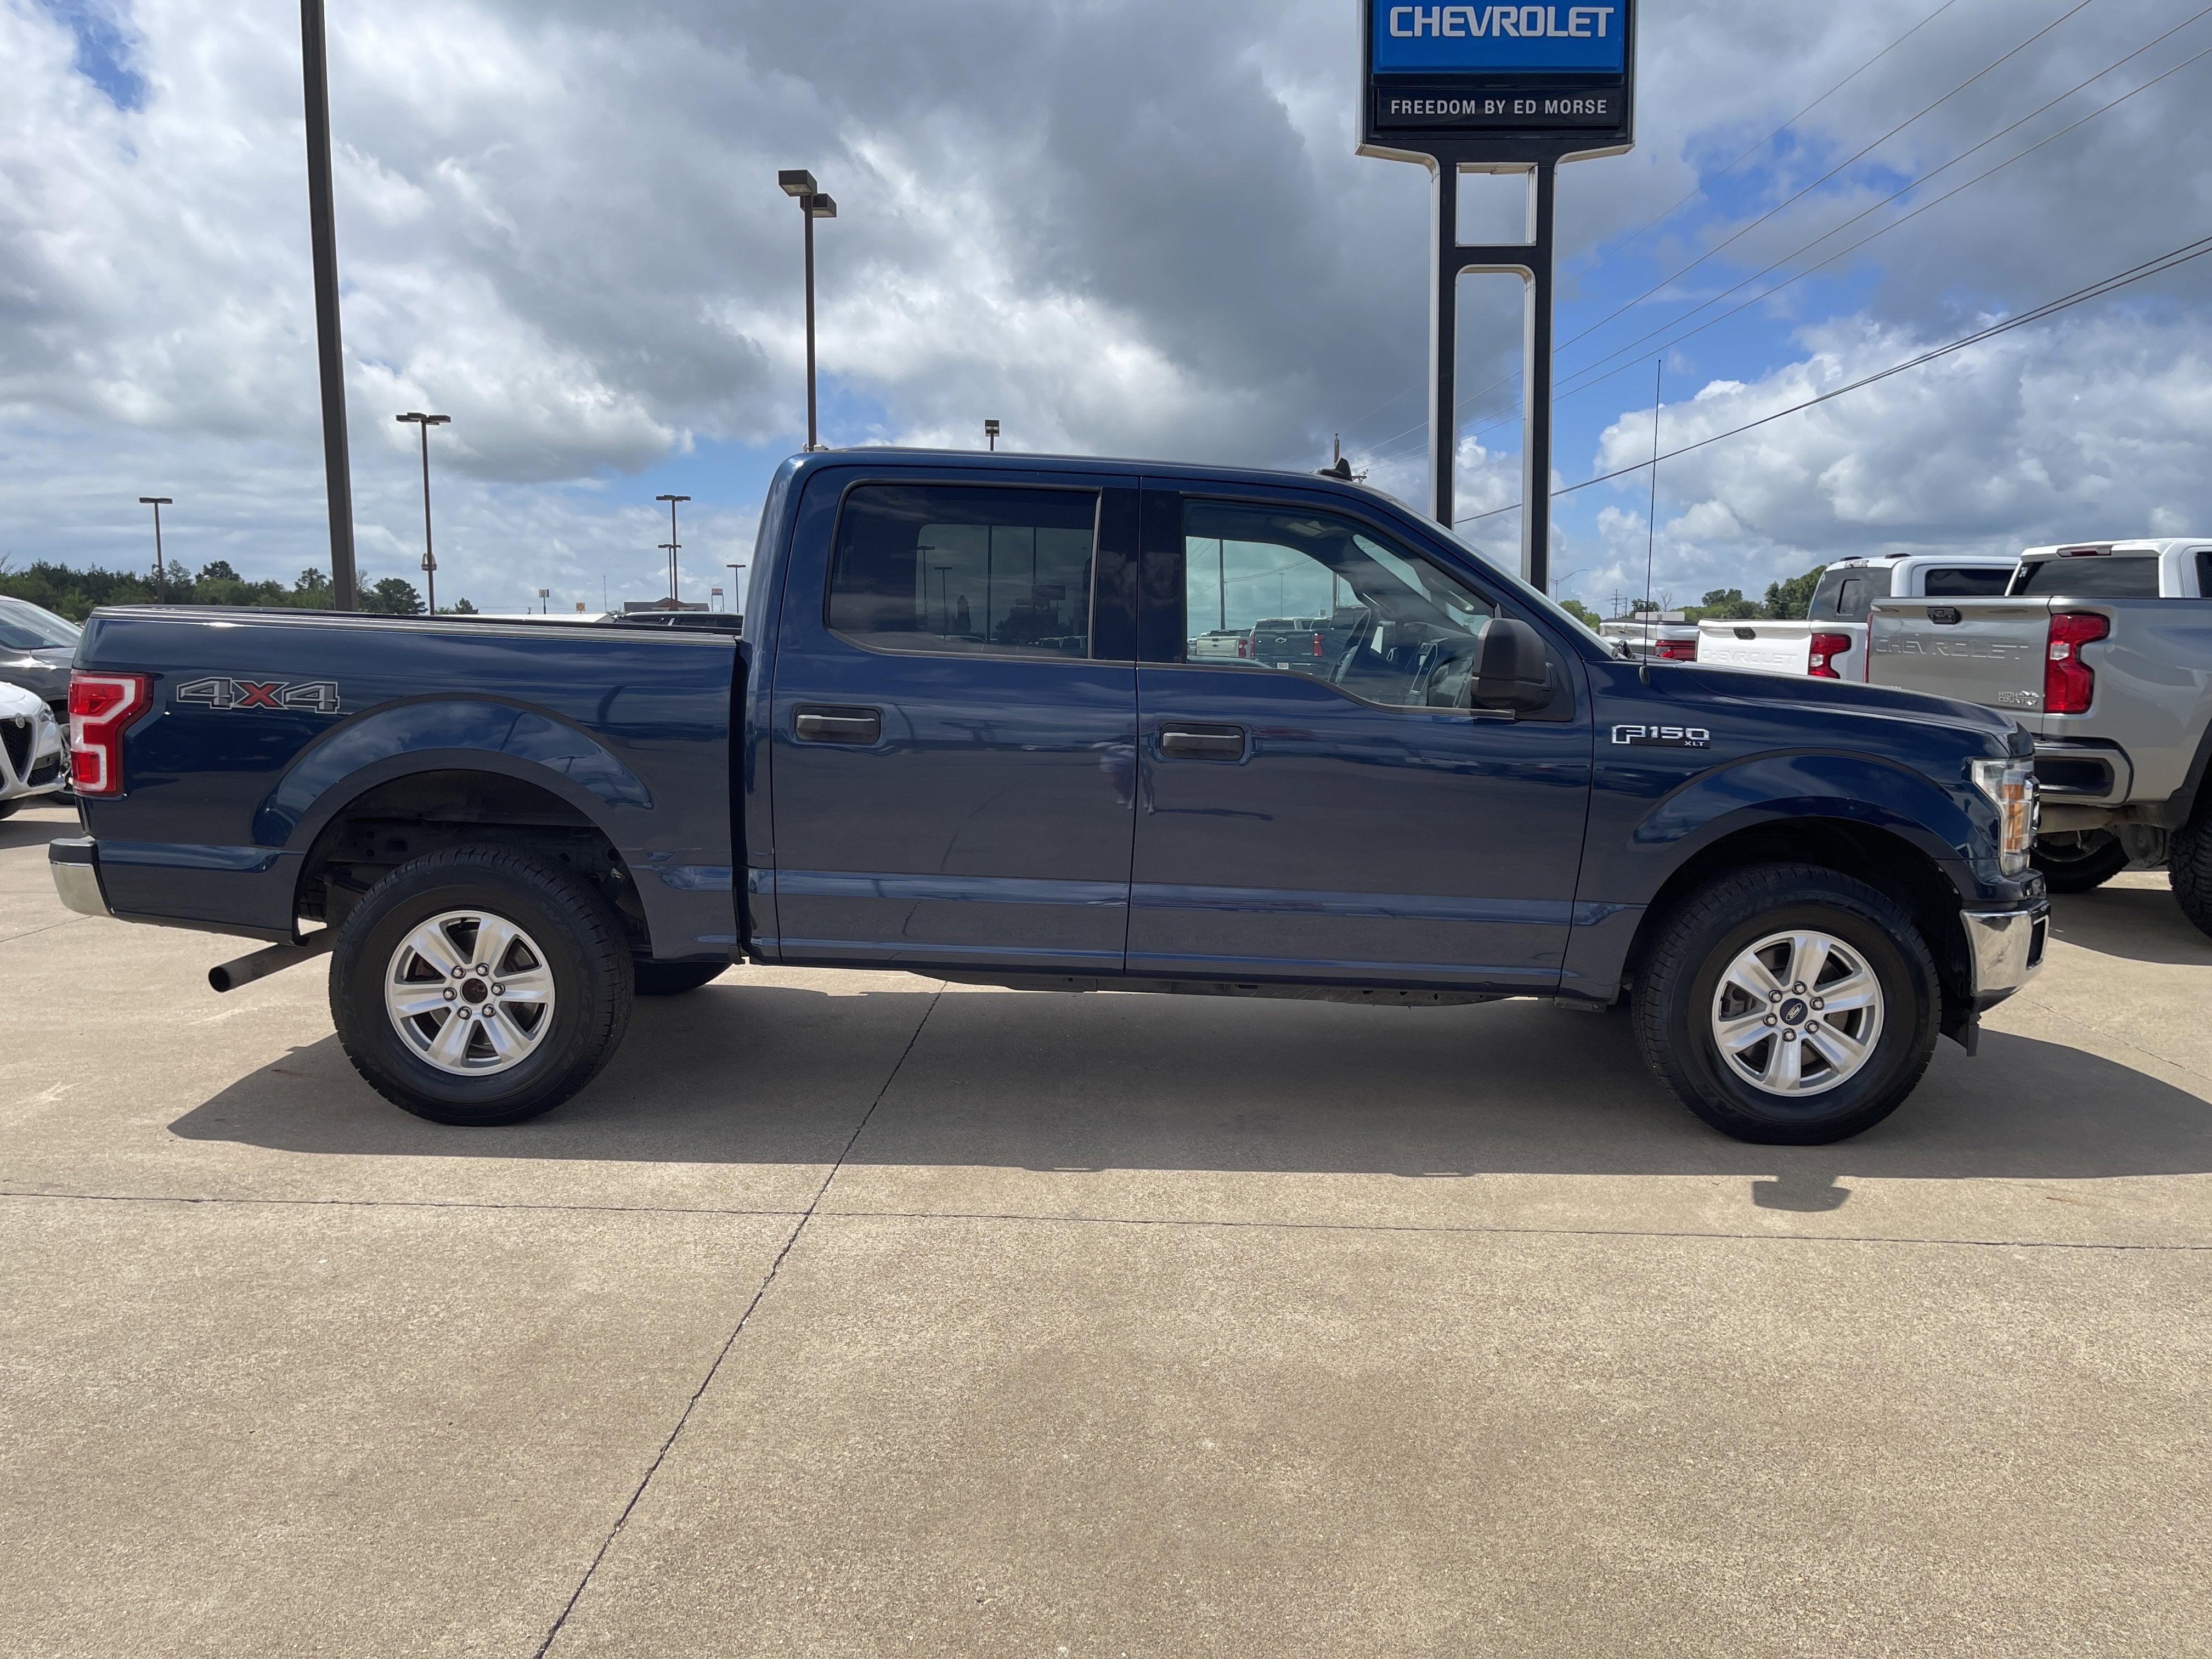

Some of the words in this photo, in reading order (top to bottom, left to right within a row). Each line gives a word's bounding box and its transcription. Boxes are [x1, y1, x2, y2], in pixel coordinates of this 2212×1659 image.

[1390, 6, 1615, 37] CHEVROLET
[1391, 100, 1476, 115] FREEDOM
[1485, 100, 1506, 115] BY
[1514, 100, 1537, 115] ED
[1544, 99, 1607, 115] MORSE
[1874, 635, 2029, 660] CHEVROLET
[1702, 649, 1798, 667] CHEVROLET
[1788, 1006, 1800, 1019] Ford
